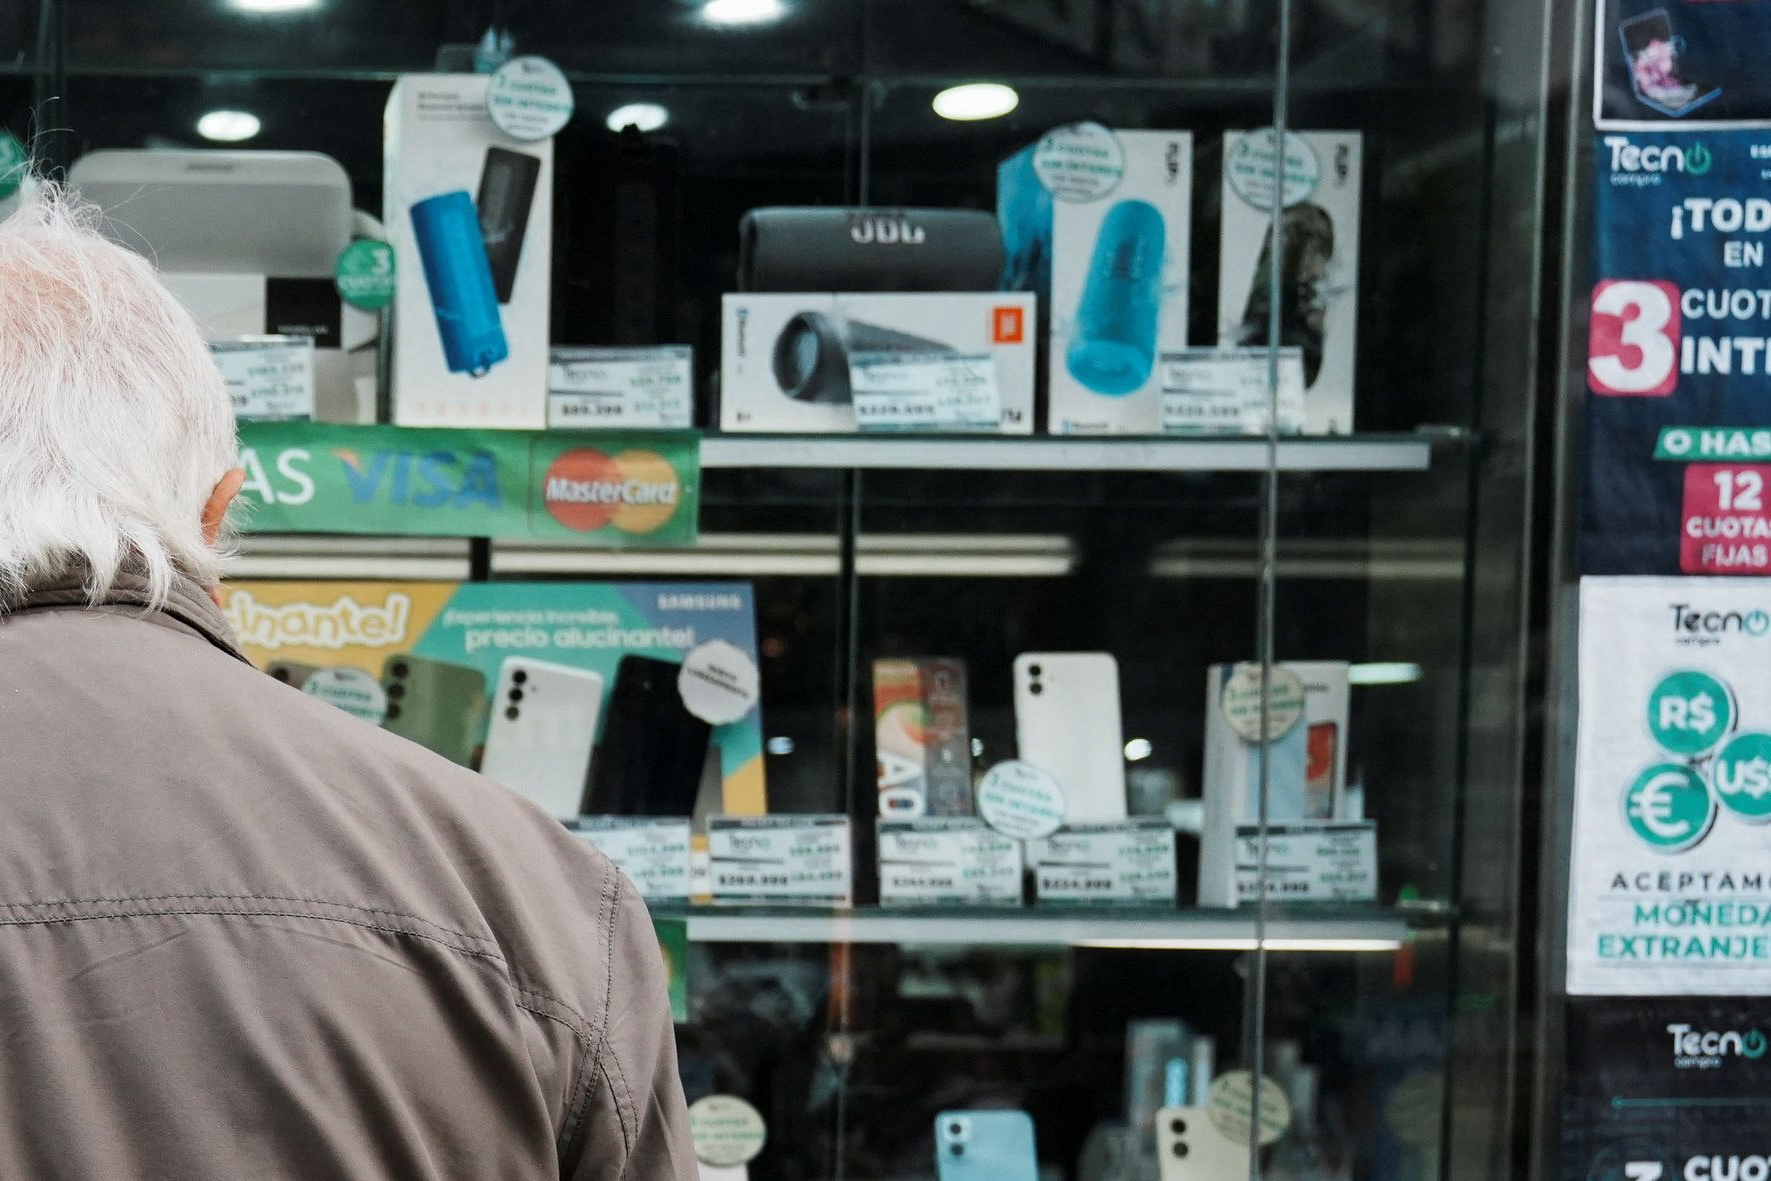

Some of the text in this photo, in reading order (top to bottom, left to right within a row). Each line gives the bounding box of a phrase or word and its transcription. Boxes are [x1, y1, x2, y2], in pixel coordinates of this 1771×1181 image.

[1724, 240, 1764, 268] EN
[1588, 280, 1676, 393] 3
[1680, 336, 1771, 375] INT
[332, 447, 502, 511] VISA
[545, 477, 678, 506] MasterCard
[1714, 469, 1764, 512] 12
[224, 589, 412, 650] inante!
[465, 625, 696, 653] precio alucinante!
[1658, 692, 1716, 736] R$
[1629, 771, 1691, 839] €
[1611, 871, 1771, 892] ACEPTAM
